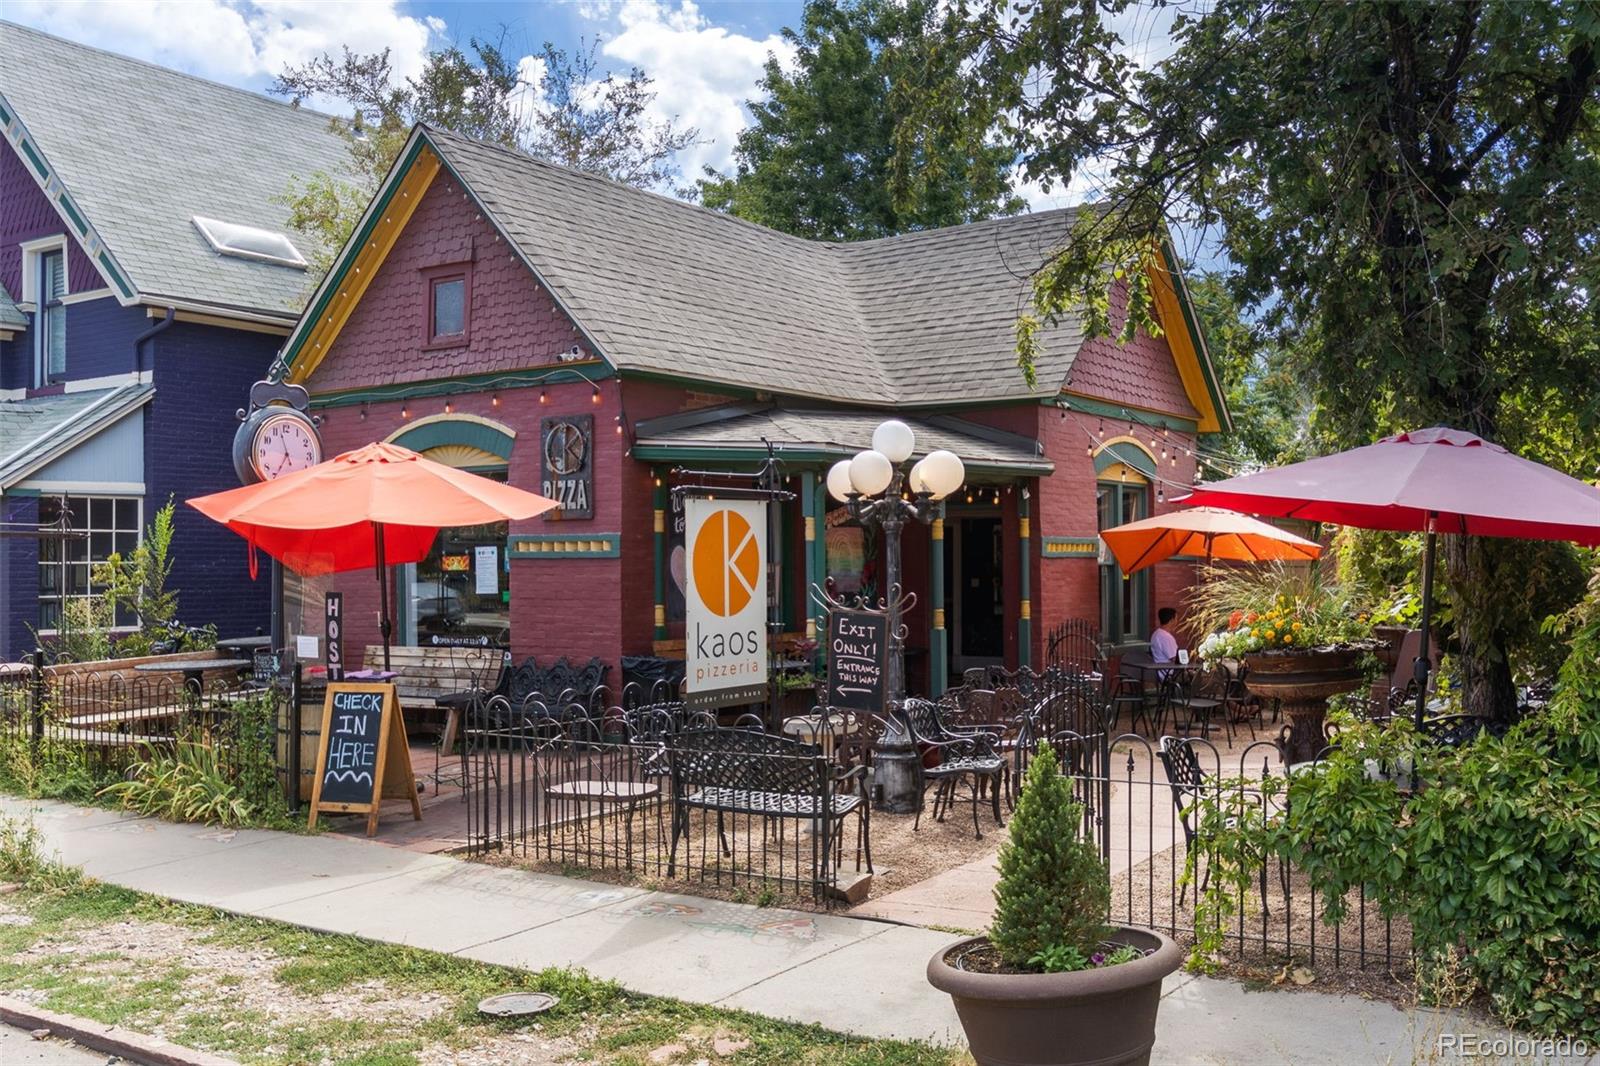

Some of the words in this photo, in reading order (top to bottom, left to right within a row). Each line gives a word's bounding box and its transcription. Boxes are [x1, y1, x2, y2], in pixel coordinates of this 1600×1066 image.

[273, 427, 278, 436] 11
[283, 424, 290, 433] 12
[264, 436, 271, 444] 10
[303, 439, 309, 447] 2
[260, 449, 265, 457] 9
[306, 452, 312, 461] 3
[264, 463, 270, 471] 8
[543, 480, 587, 510] PIZZA
[839, 618, 876, 639] EXIT
[327, 598, 341, 680] HOST
[696, 622, 758, 659] kaos
[833, 638, 877, 659] ONLY!
[696, 659, 759, 684] pizzeria
[836, 658, 881, 676] ENTRANCE
[838, 673, 857, 683] THIS
[859, 674, 878, 686] WAY
[334, 693, 382, 713] CHECK
[335, 715, 368, 737] IN
[328, 736, 375, 770] HERE
